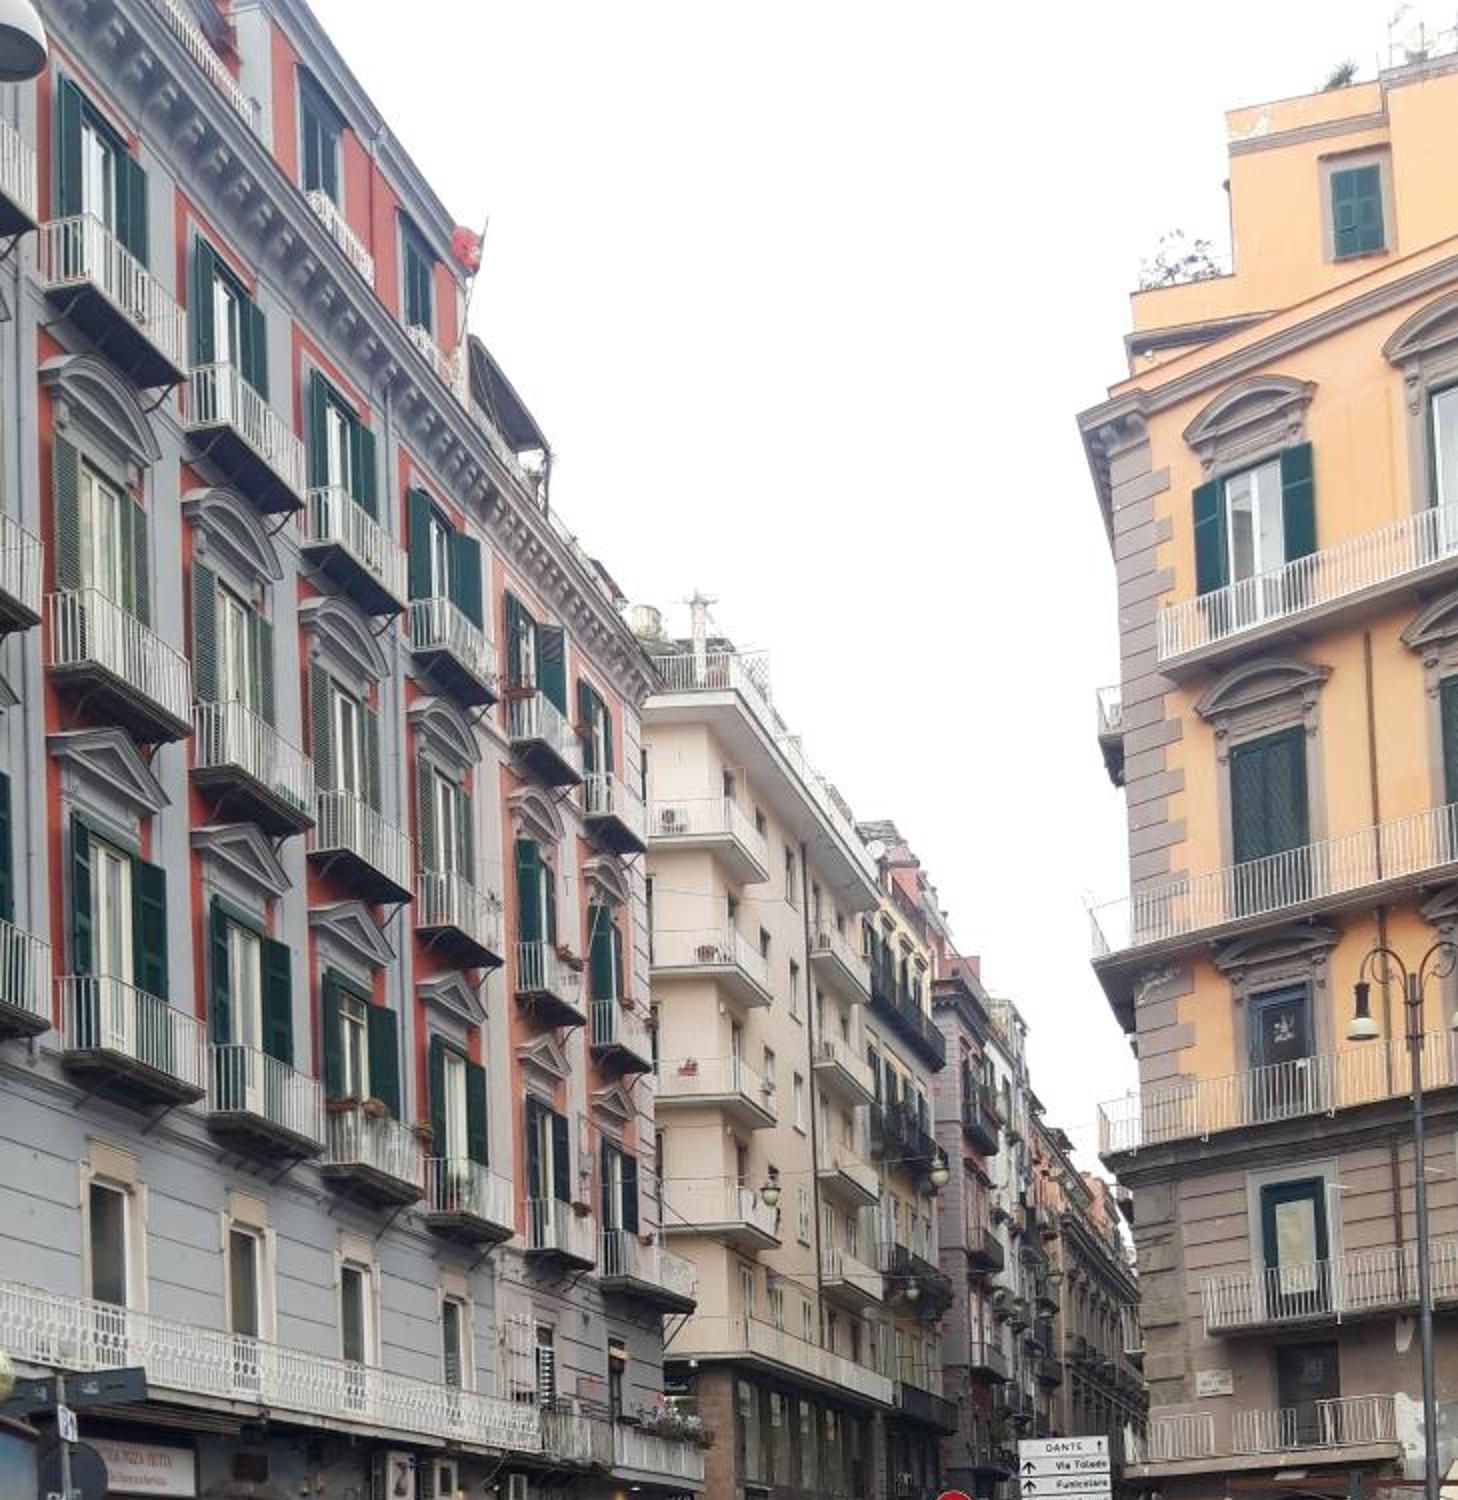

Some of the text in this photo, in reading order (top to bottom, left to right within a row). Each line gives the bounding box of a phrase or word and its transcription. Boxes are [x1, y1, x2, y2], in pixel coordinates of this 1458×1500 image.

[1045, 1442, 1083, 1453] DANTE
[1056, 1460, 1107, 1470] Via Toledo
